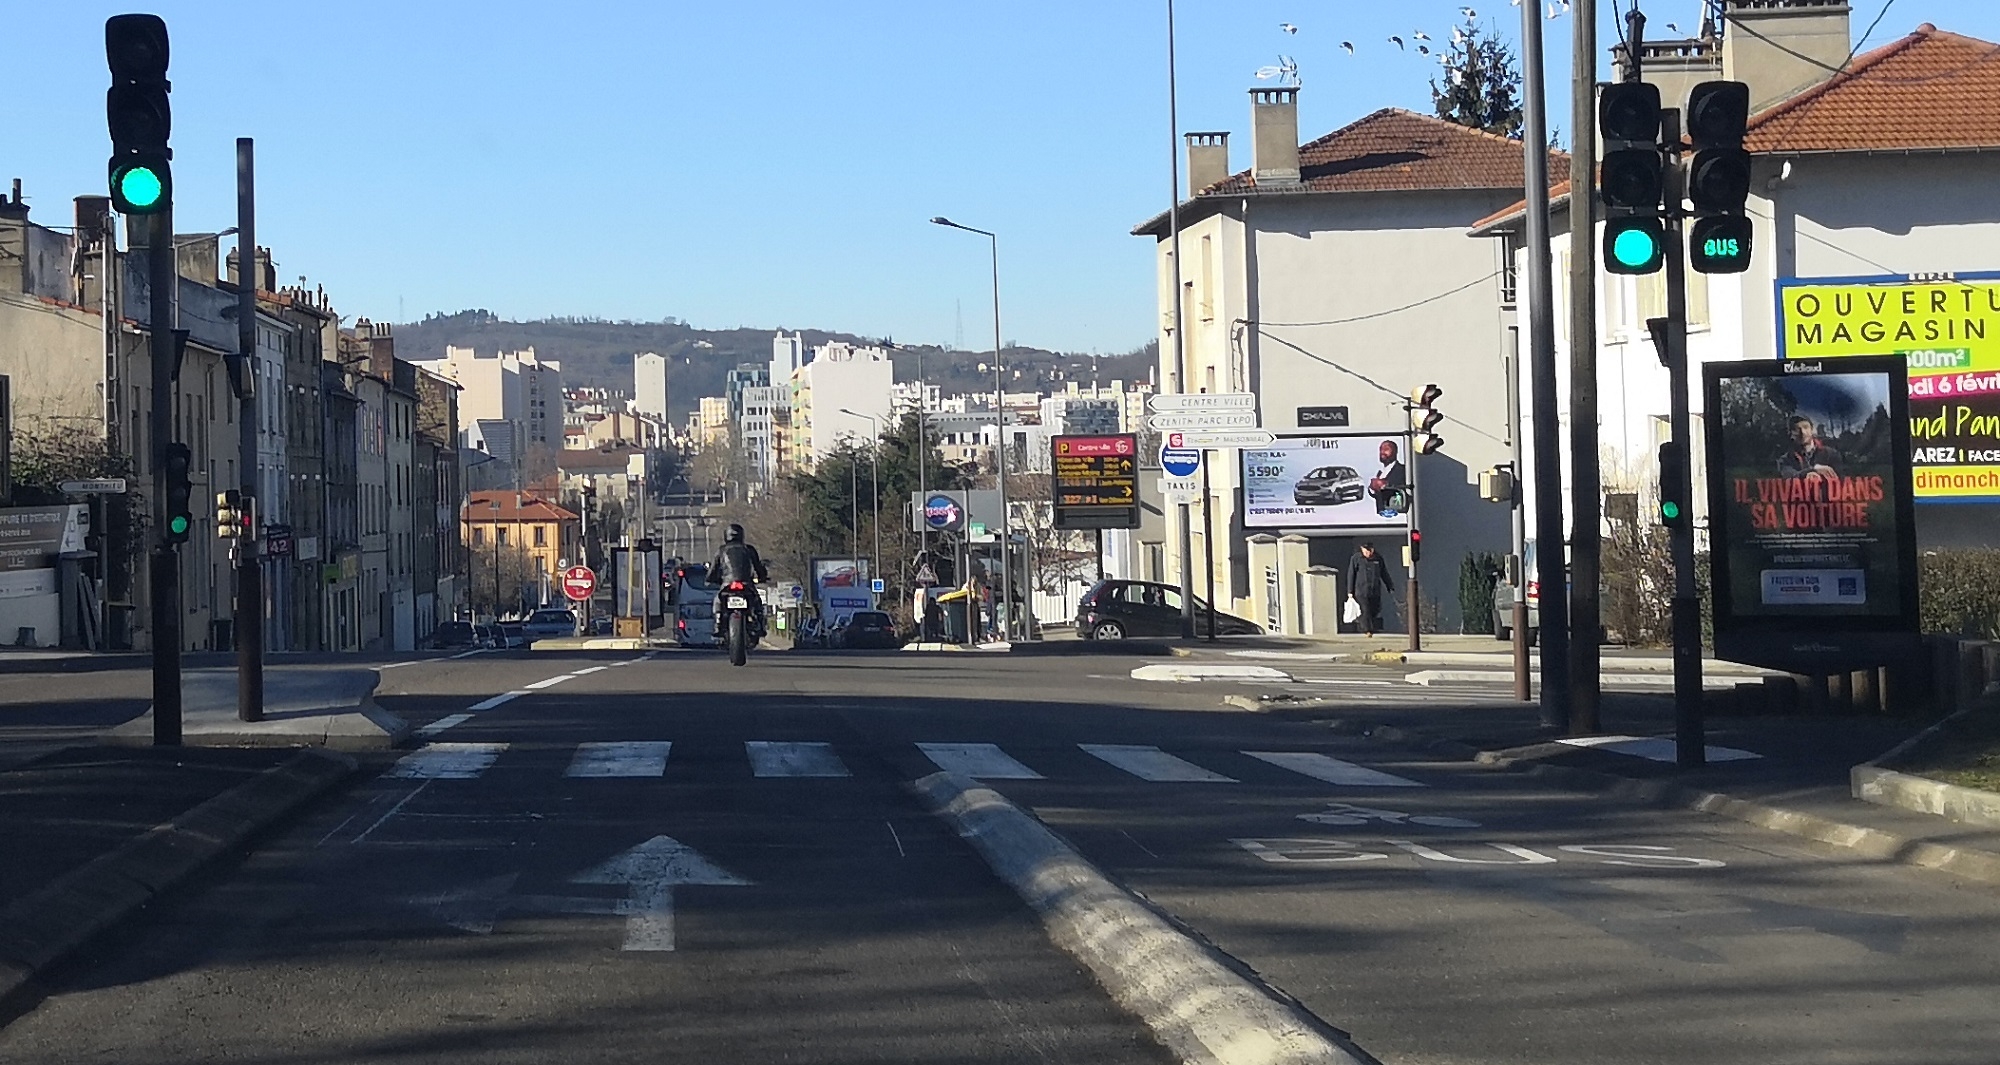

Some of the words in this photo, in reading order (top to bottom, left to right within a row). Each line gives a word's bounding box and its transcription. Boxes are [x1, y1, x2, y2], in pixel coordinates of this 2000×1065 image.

[1704, 239, 1738, 256] BUS
[1796, 288, 2000, 318] OUVERTU
[1797, 318, 1985, 345] MAGASIN
[1938, 375, 1952, 393] 6
[1181, 399, 1218, 407] CENTRE
[1224, 397, 1250, 406] VILLE
[1160, 417, 1192, 426] ZENITH
[1197, 416, 1221, 425] PARC
[1226, 415, 1251, 424] EXPO
[1912, 447, 1956, 463] AREZ
[1167, 482, 1196, 490] TAXIS
[1916, 470, 1999, 488] dimanch
[1735, 479, 1750, 503] IL
[1757, 477, 1822, 503] VIVAIT
[1828, 475, 1884, 502] DANS
[1752, 503, 1778, 528] SA
[1782, 502, 1869, 528] VOITURE
[270, 539, 288, 553] 42
[1228, 837, 1726, 868] BUS
